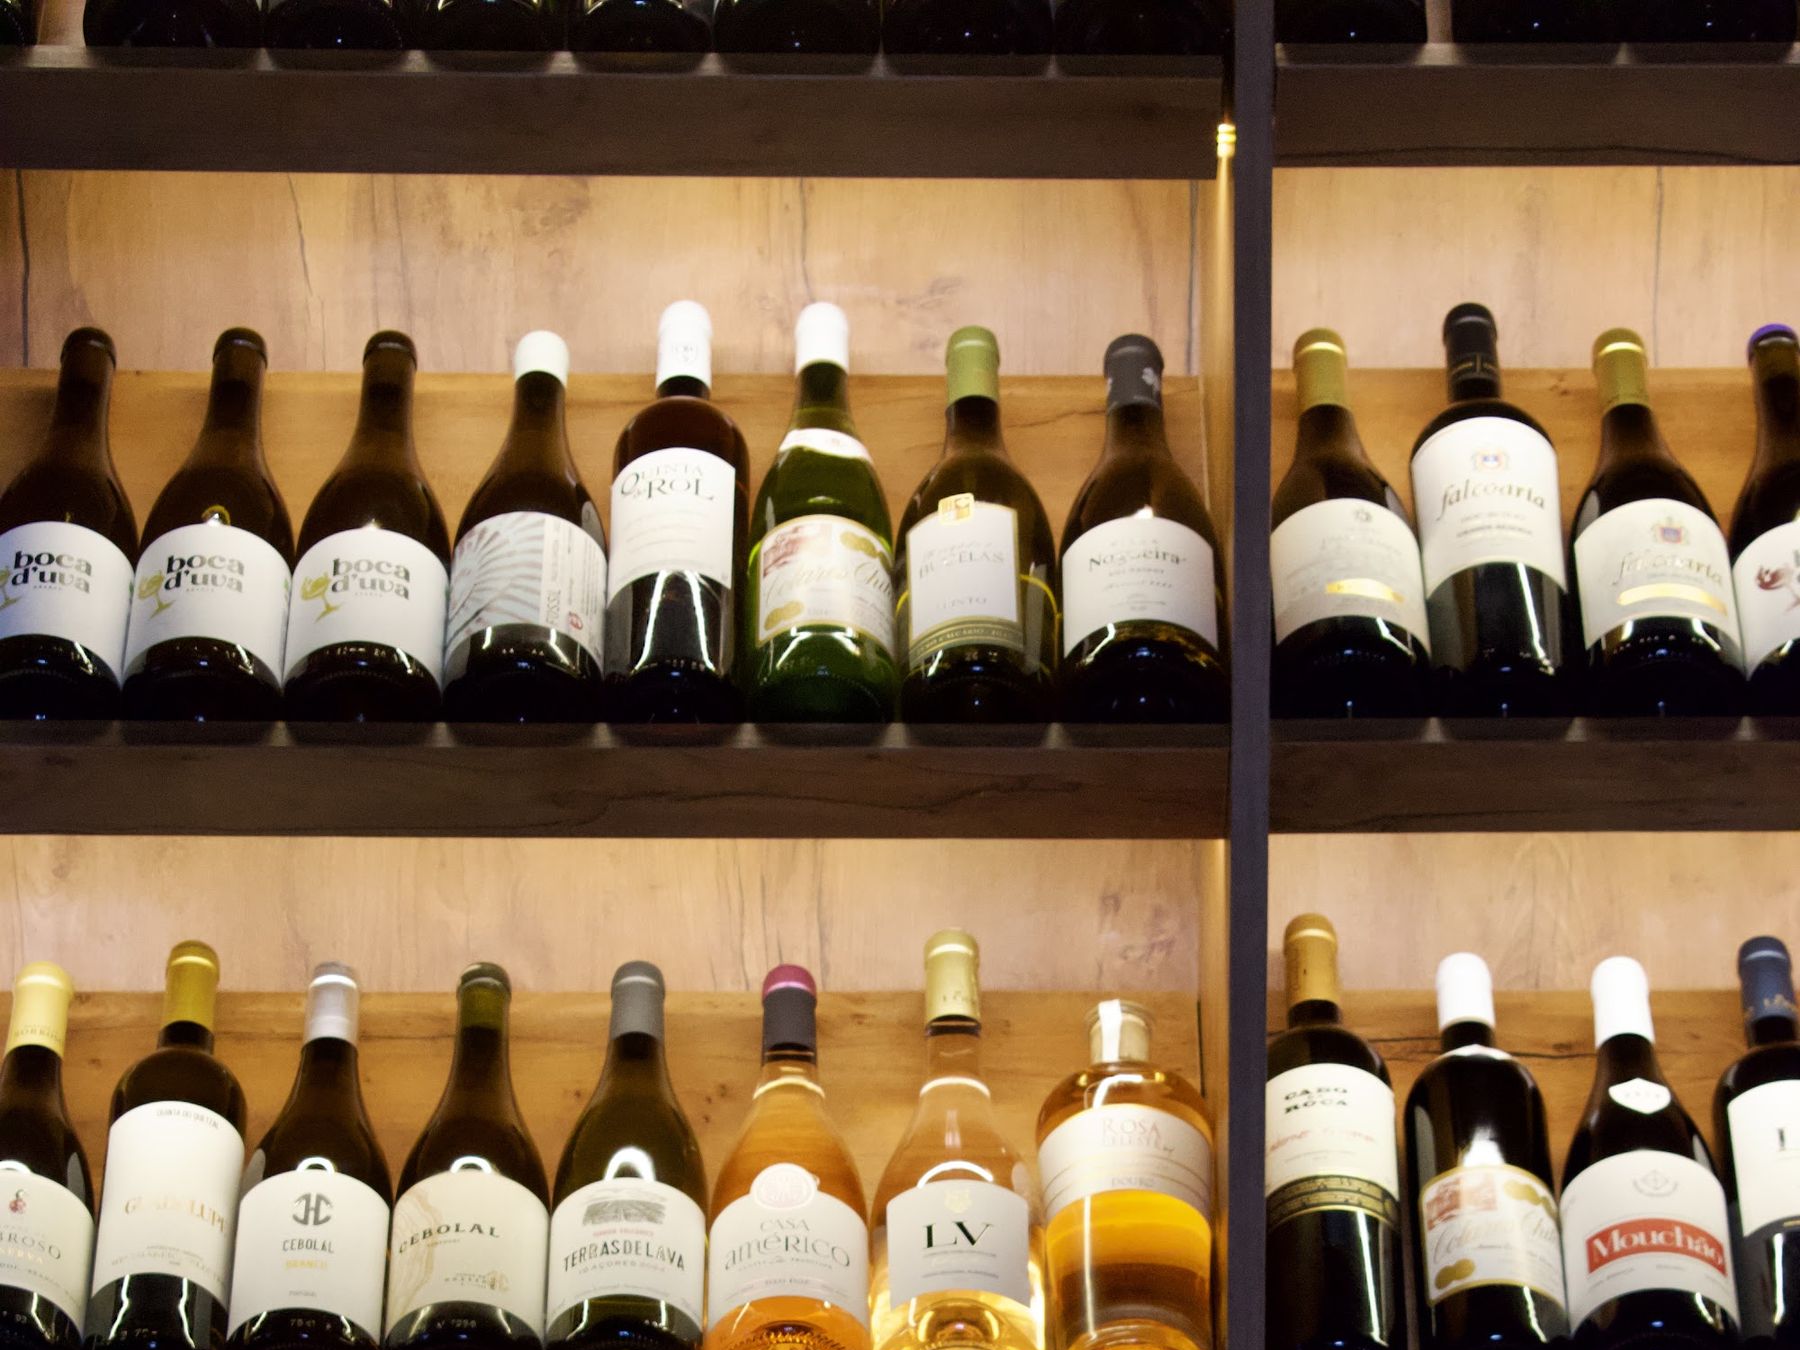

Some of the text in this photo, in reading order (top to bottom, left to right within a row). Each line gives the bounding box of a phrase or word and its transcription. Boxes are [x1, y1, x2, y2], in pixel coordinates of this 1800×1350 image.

[648, 479, 714, 500] ROL
[14, 551, 92, 576] boca
[166, 555, 245, 576] boca
[333, 558, 411, 582] boca
[11, 567, 90, 594] d'uva
[164, 570, 243, 593] d'uva
[331, 574, 410, 600] d'uva
[1284, 1086, 1348, 1101] CABO
[1284, 1098, 1348, 1114] ROCA
[1103, 1117, 1161, 1138] ROSA
[760, 1217, 810, 1232] CASA
[922, 1220, 994, 1250] LV
[0, 1231, 61, 1260] ROSO
[282, 1238, 335, 1254] CEBOLAL
[399, 1222, 501, 1254] CEBOLAL
[1591, 1225, 1723, 1266] Mouchão
